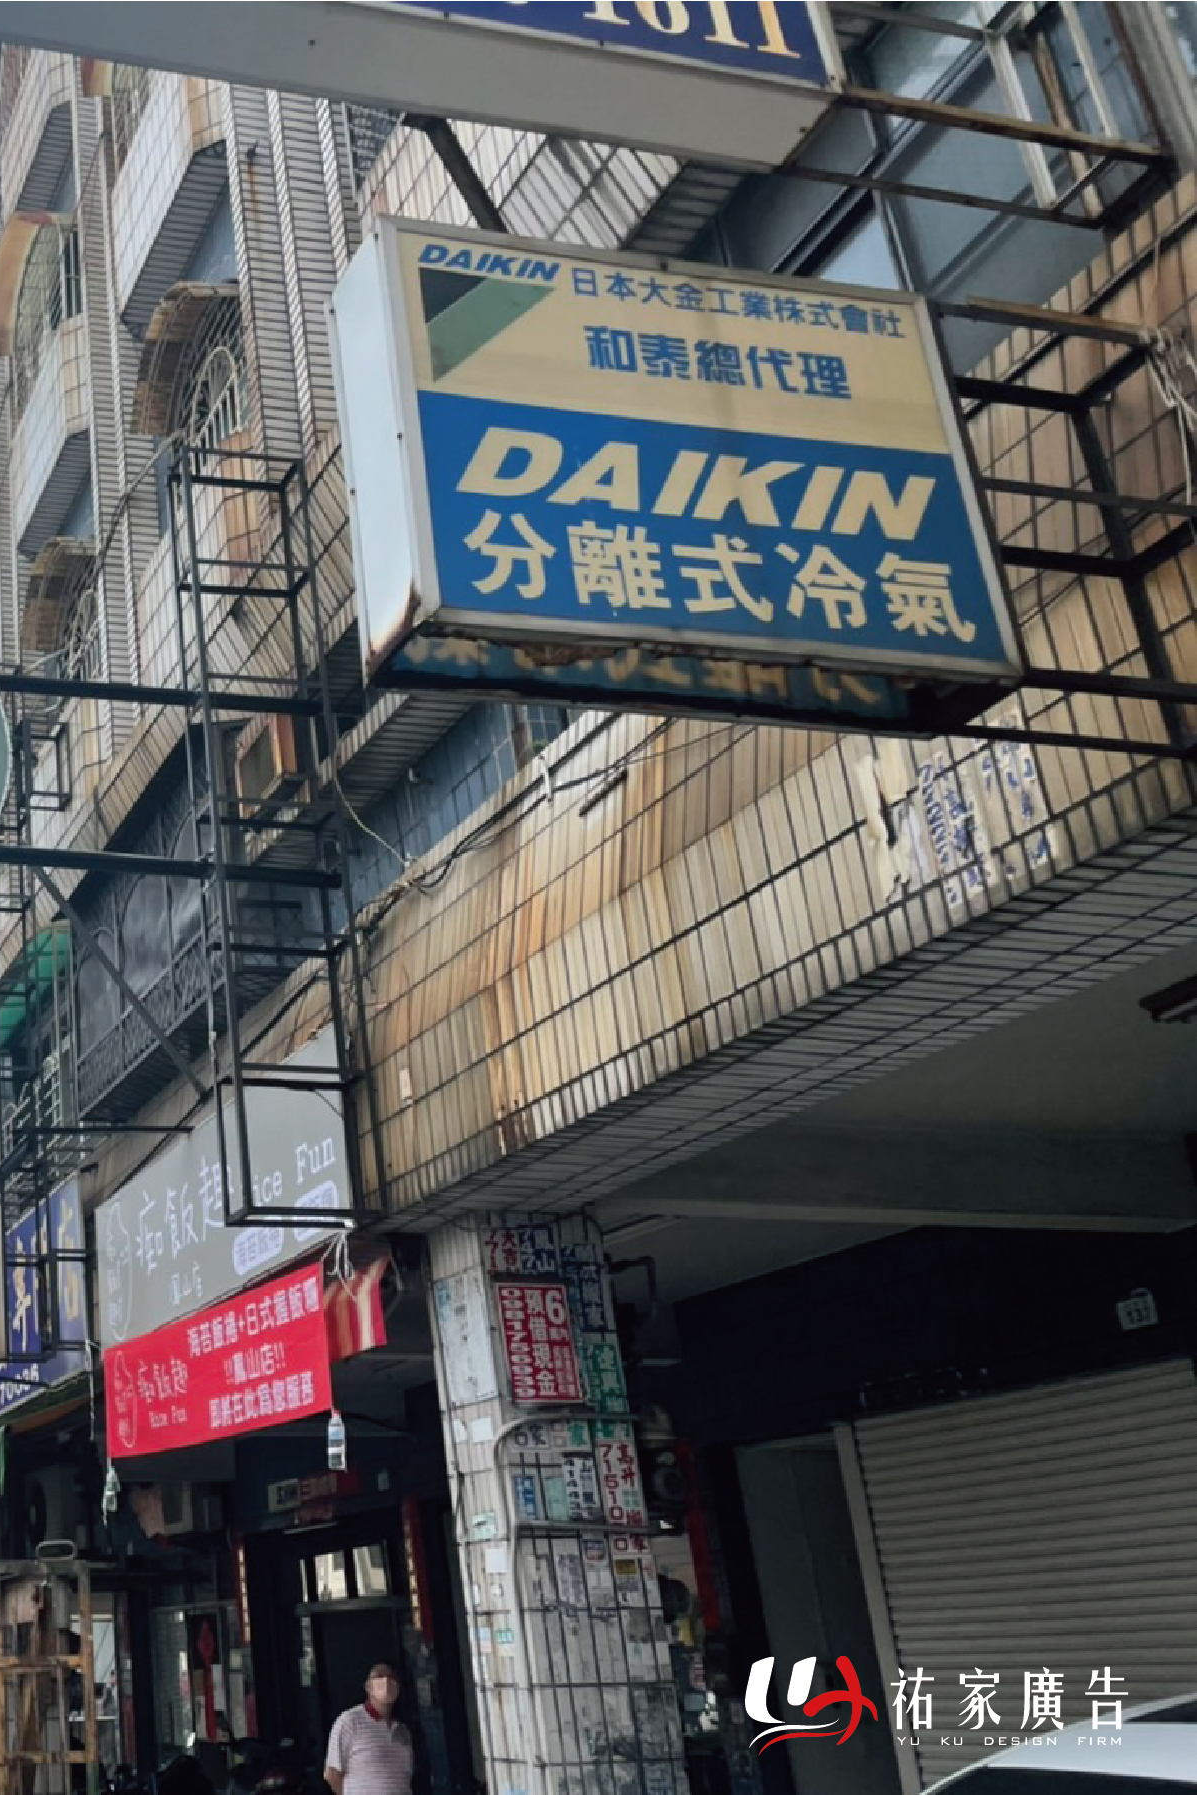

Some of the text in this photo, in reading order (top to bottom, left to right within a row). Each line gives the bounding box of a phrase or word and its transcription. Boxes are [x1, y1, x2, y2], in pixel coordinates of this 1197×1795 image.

[418, 243, 560, 283] DAIKIN
[571, 265, 907, 342] 日本大金工業株式會社
[583, 324, 853, 401] 和泰總代理
[455, 426, 937, 542] DAIKIN
[463, 508, 977, 643] 分離式冷氣
[252, 1136, 336, 1207] ice Fun
